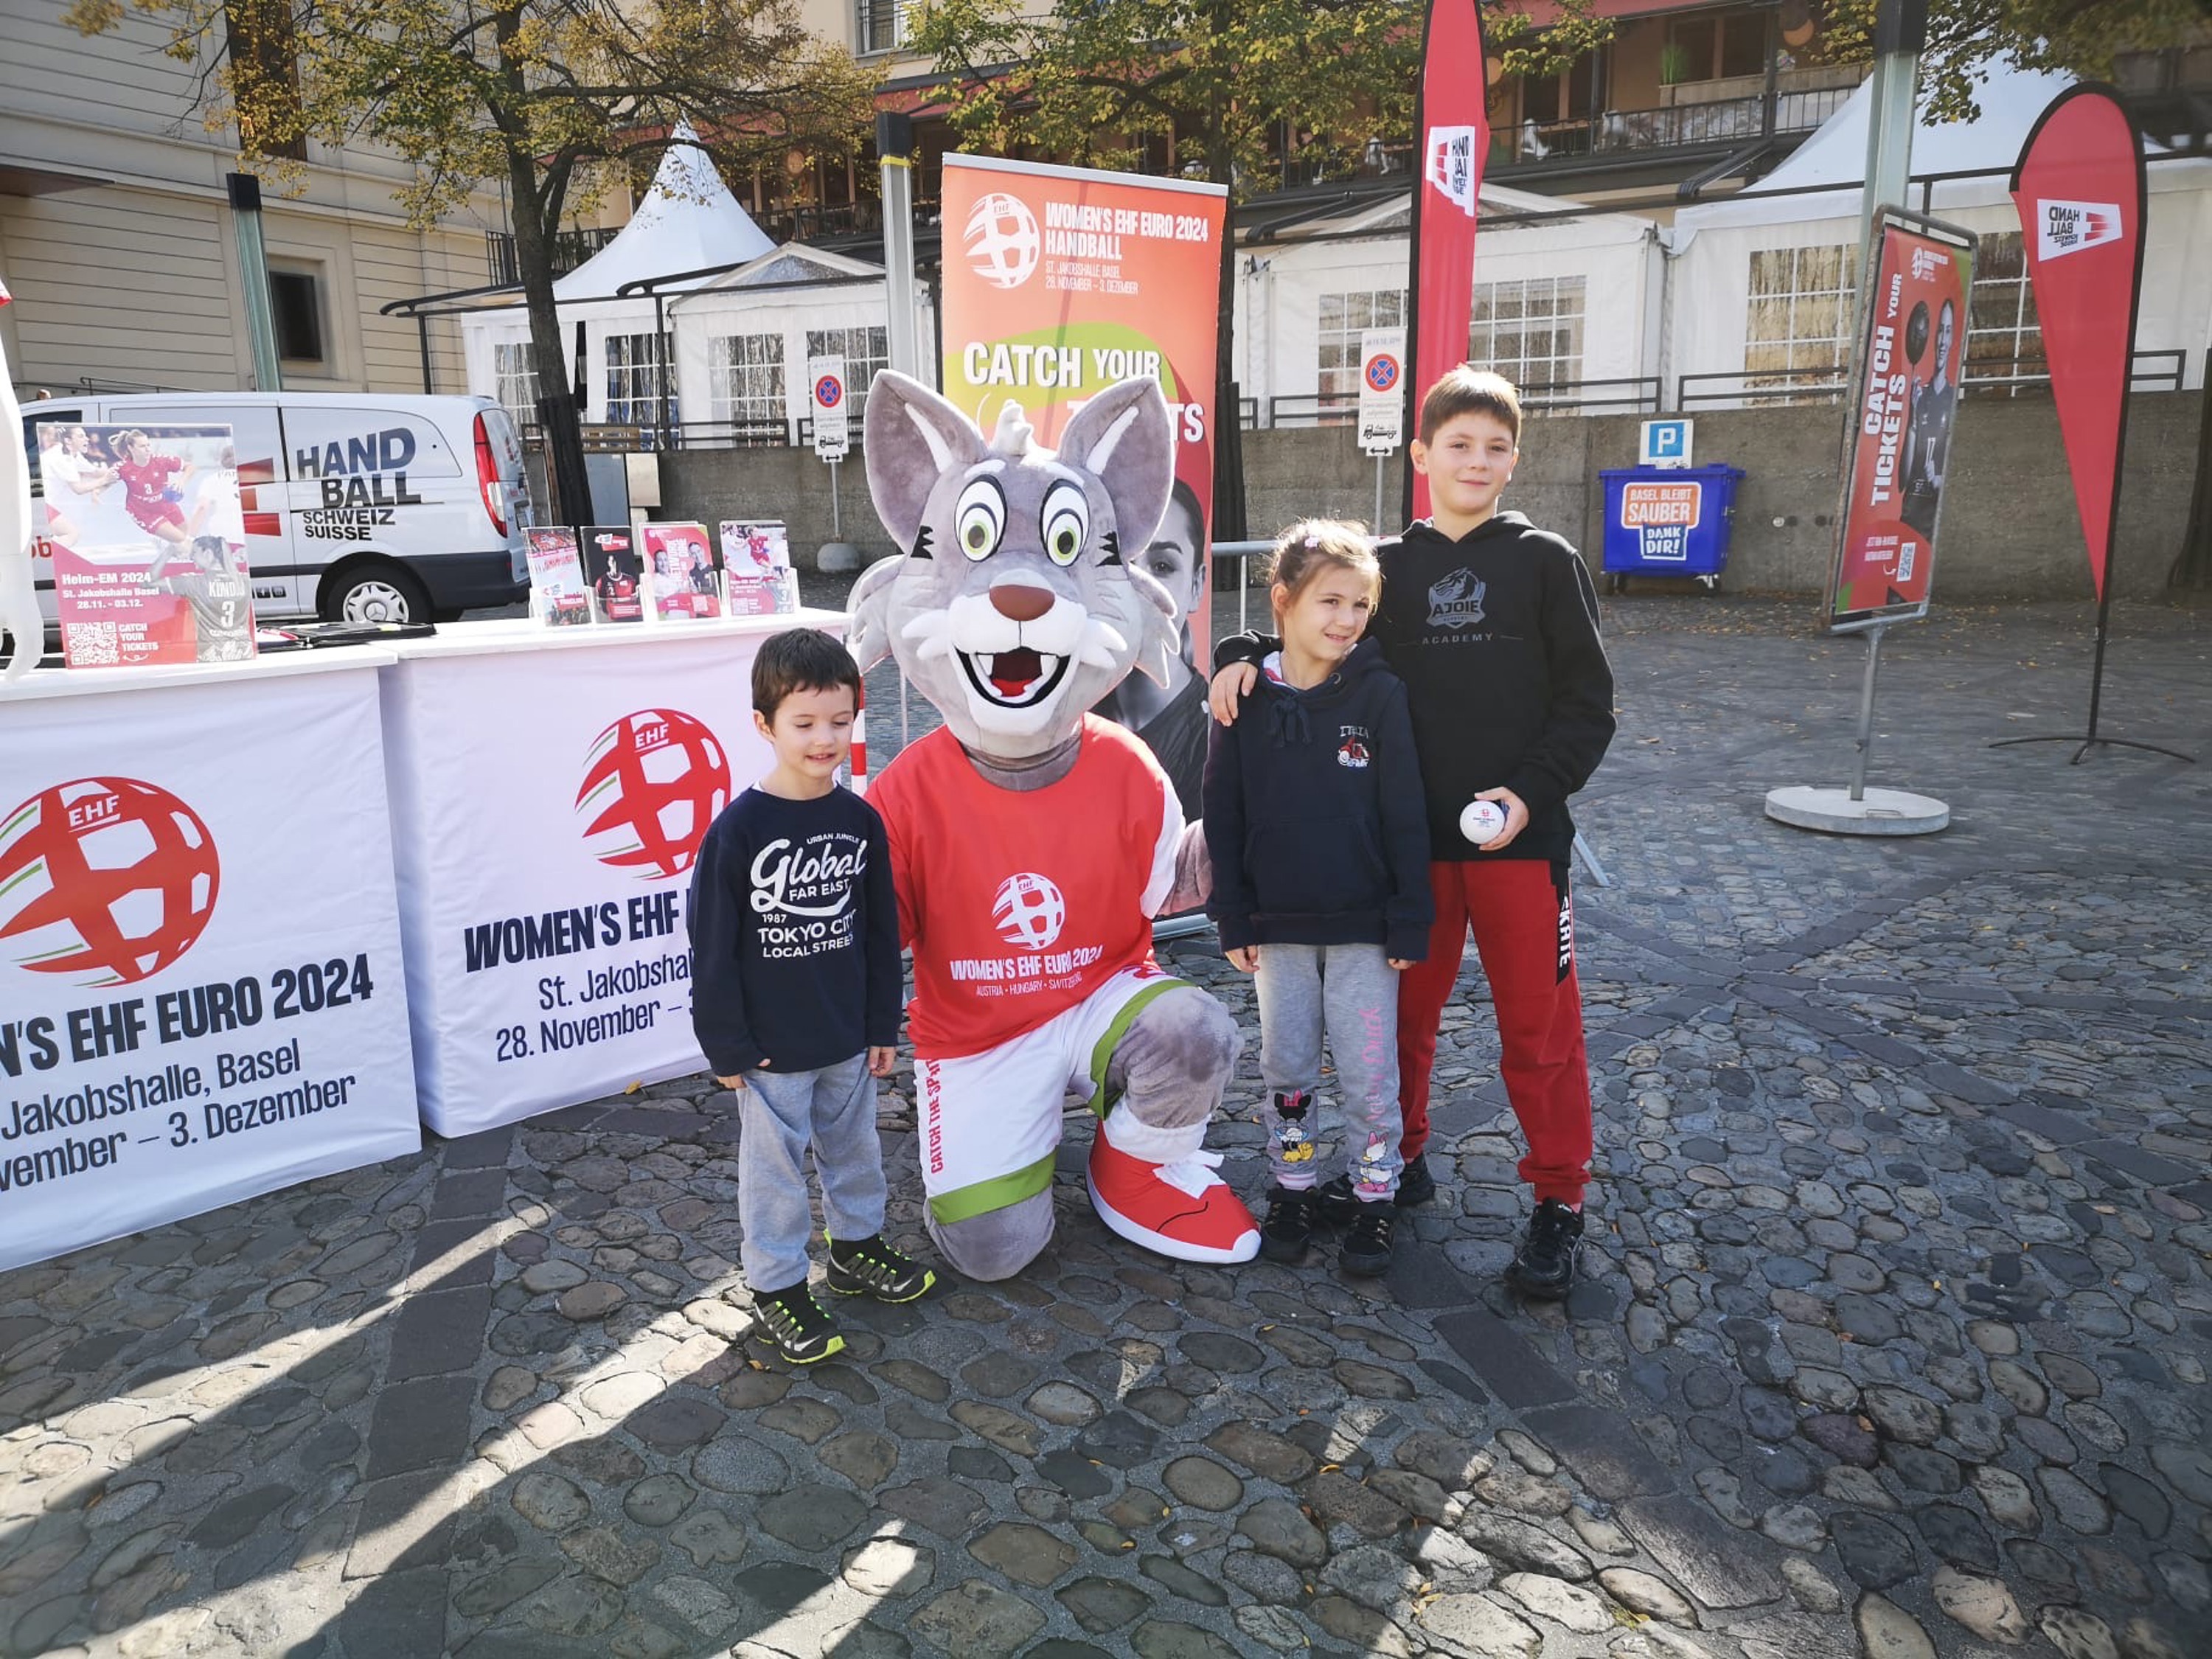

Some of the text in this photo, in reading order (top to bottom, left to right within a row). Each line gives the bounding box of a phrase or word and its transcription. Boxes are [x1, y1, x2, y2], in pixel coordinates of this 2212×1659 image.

[1046, 201, 1208, 243] WOMEN'S EHF EURO 2024
[1046, 229, 1122, 260] HANDBALL
[1057, 276, 1092, 291] NOVEMBER
[963, 342, 1162, 388] CATCH YOUR
[1864, 274, 1902, 434] CATCH YOUR
[296, 427, 416, 479] HAND
[1658, 428, 1676, 453] P
[1870, 374, 1906, 507] TICKETS
[321, 471, 421, 509] BALL
[1630, 488, 1692, 501] BASEL BLEIBT
[303, 509, 395, 525] SCHWEIZ
[1628, 502, 1691, 522] SAUBER
[305, 526, 372, 540] SUISSE
[1646, 527, 1680, 539] DANK
[1646, 539, 1680, 554] DIR!
[121, 572, 152, 582] 2024
[221, 601, 234, 627] 3
[1433, 600, 1479, 616] AJOIE
[119, 623, 147, 631] CATCH
[1422, 633, 1493, 645] ACADEMY
[122, 642, 159, 651] TICKETS
[635, 723, 669, 748] EHF
[69, 794, 119, 827] EHF
[807, 832, 860, 845] URBAN JUNGLE
[750, 838, 868, 913] Global
[789, 878, 850, 902] FAR EAST
[757, 908, 857, 944] TOKYO CITY
[762, 914, 787, 923] 1987
[465, 901, 622, 973] WOMEN'S
[627, 891, 679, 941] EHF
[762, 945, 810, 959] LOCAL
[538, 977, 573, 1010] St.
[580, 948, 693, 1004] Jakobshal
[950, 958, 1016, 981] WOMEN'S
[1017, 955, 1043, 978] EHF
[975, 984, 1004, 997] AUSTRIA
[1009, 979, 1043, 995] HUNGARY
[66, 998, 147, 1062] EHF
[156, 976, 262, 1044] EURO
[271, 953, 374, 1020] 2024
[496, 1025, 535, 1062] 28.
[541, 1001, 661, 1053] November
[1, 1037, 302, 1140] Jakobshalle, Basel
[928, 1096, 941, 1125] THE
[0, 1132, 127, 1192] vember
[168, 1111, 198, 1147] 3.
[205, 1075, 356, 1140] Dezember
[928, 1125, 944, 1174] CATCH
